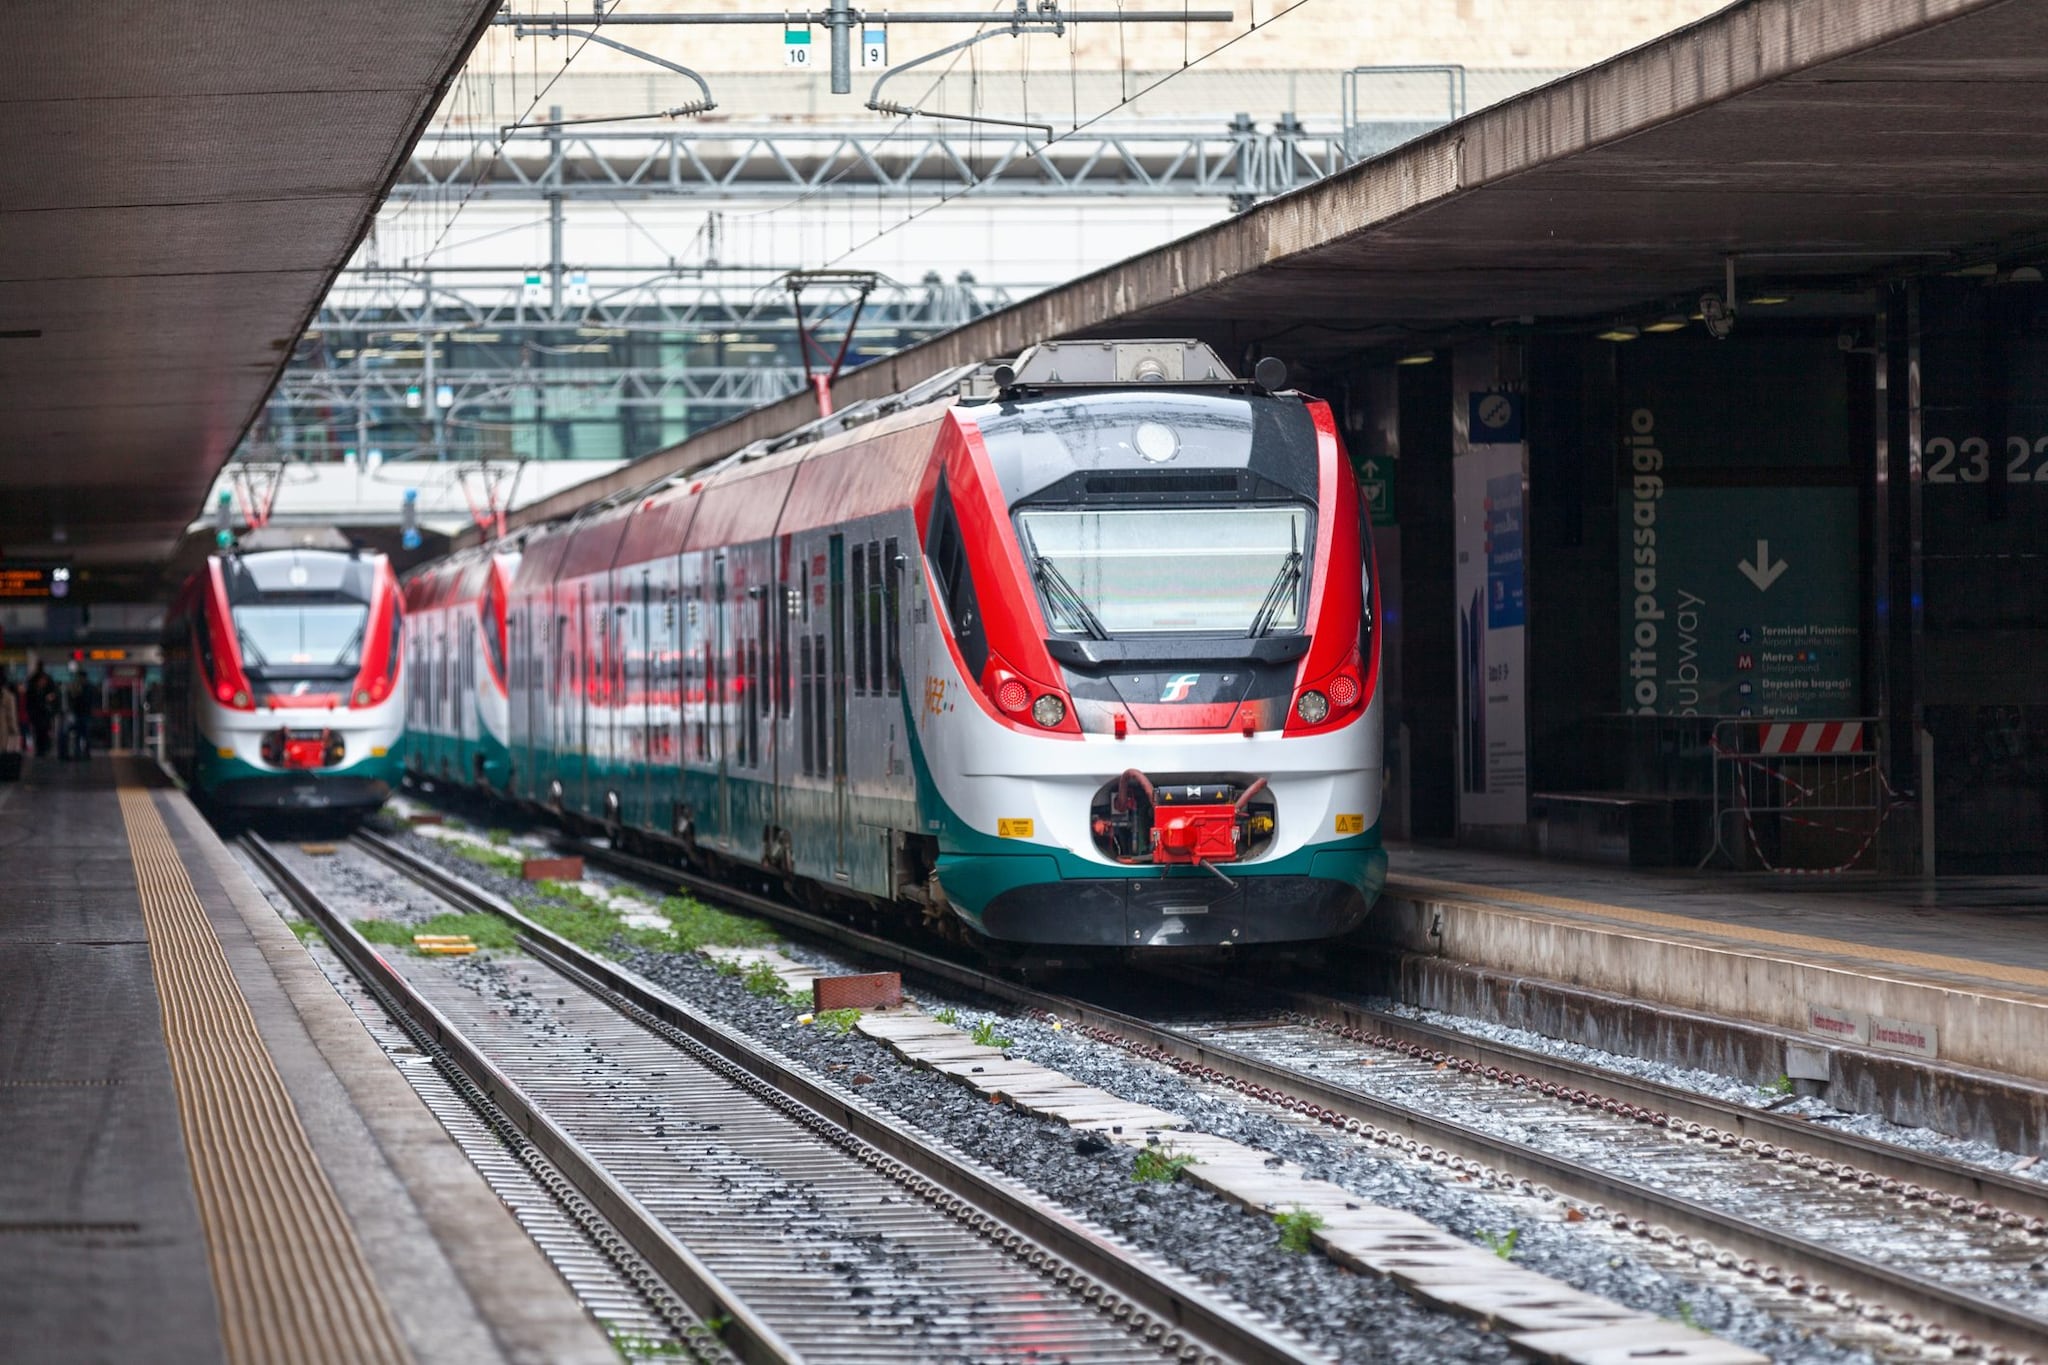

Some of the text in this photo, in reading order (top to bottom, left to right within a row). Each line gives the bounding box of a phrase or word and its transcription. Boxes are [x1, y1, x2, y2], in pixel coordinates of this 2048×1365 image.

[790, 50, 805, 62] 10
[871, 49, 879, 61] 9
[1925, 437, 1990, 483] 23
[1762, 626, 1807, 636] Terminal
[1762, 652, 1794, 662] Metro
[1762, 679, 1809, 689] Deposito
[1762, 705, 1798, 715] Servizi
